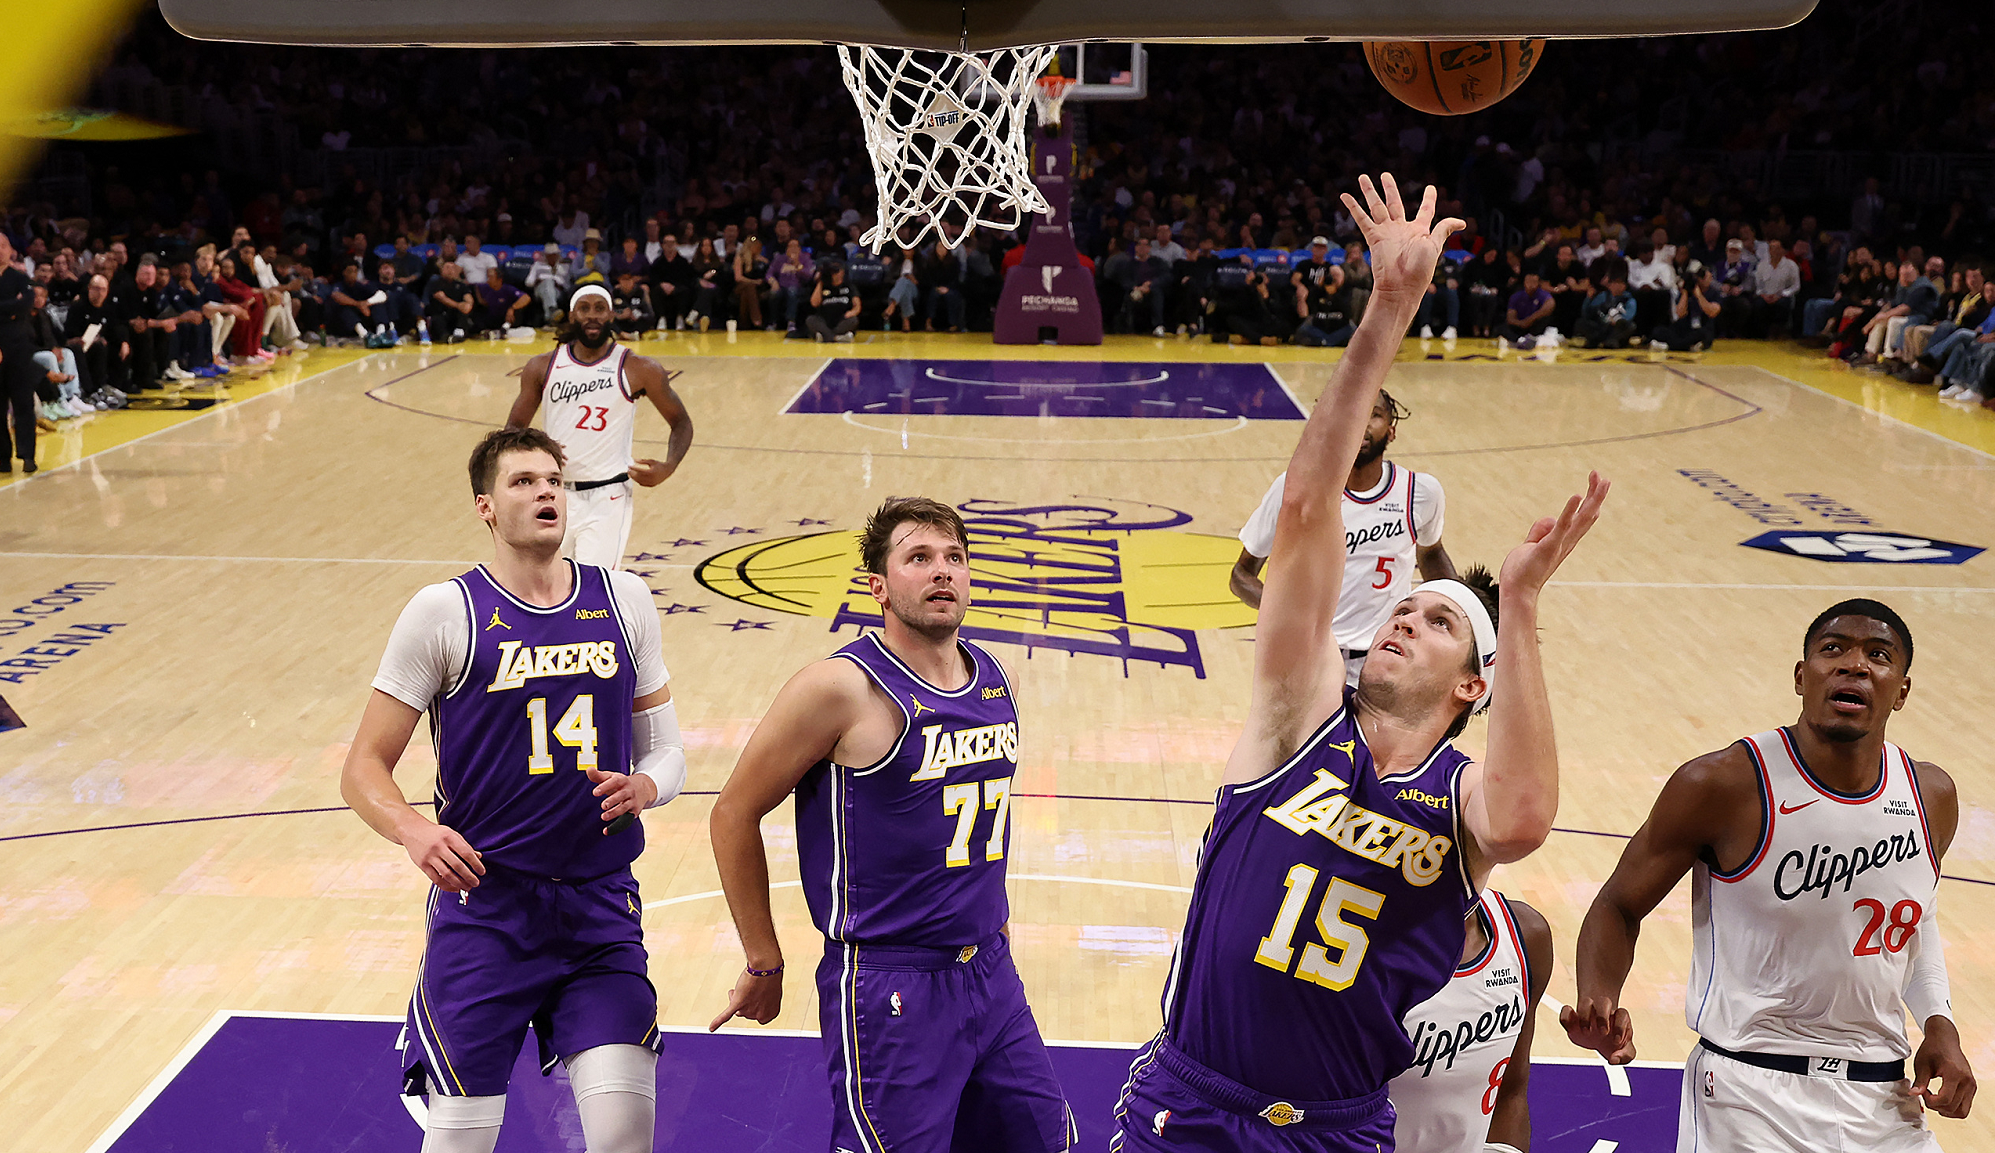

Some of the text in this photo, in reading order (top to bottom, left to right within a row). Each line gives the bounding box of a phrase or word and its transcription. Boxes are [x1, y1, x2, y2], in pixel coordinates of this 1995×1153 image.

[935, 112, 959, 127] TIP-OFF
[550, 377, 613, 403] Clippers
[575, 405, 609, 432] 23
[1345, 519, 1405, 555] ppers
[1371, 556, 1395, 590] 5
[575, 608, 610, 620] Albert
[0, 623, 127, 684] ARENA
[487, 640, 619, 693] LAKERS
[981, 685, 1007, 701] Albert
[527, 694, 598, 775] 14
[909, 721, 1018, 783] LAKERS
[1394, 788, 1450, 809] Albert
[1883, 807, 1916, 816] RWANDA
[1888, 800, 1908, 808] VISIT
[943, 776, 1012, 868] 77
[1262, 767, 1453, 887] LAKERS
[1773, 829, 1921, 901] Clippers
[1254, 862, 1387, 992] 15
[1852, 898, 1922, 957] 28
[1486, 975, 1519, 988] RWANDA
[1491, 968, 1511, 977] VISIT
[1411, 994, 1523, 1079] lippers
